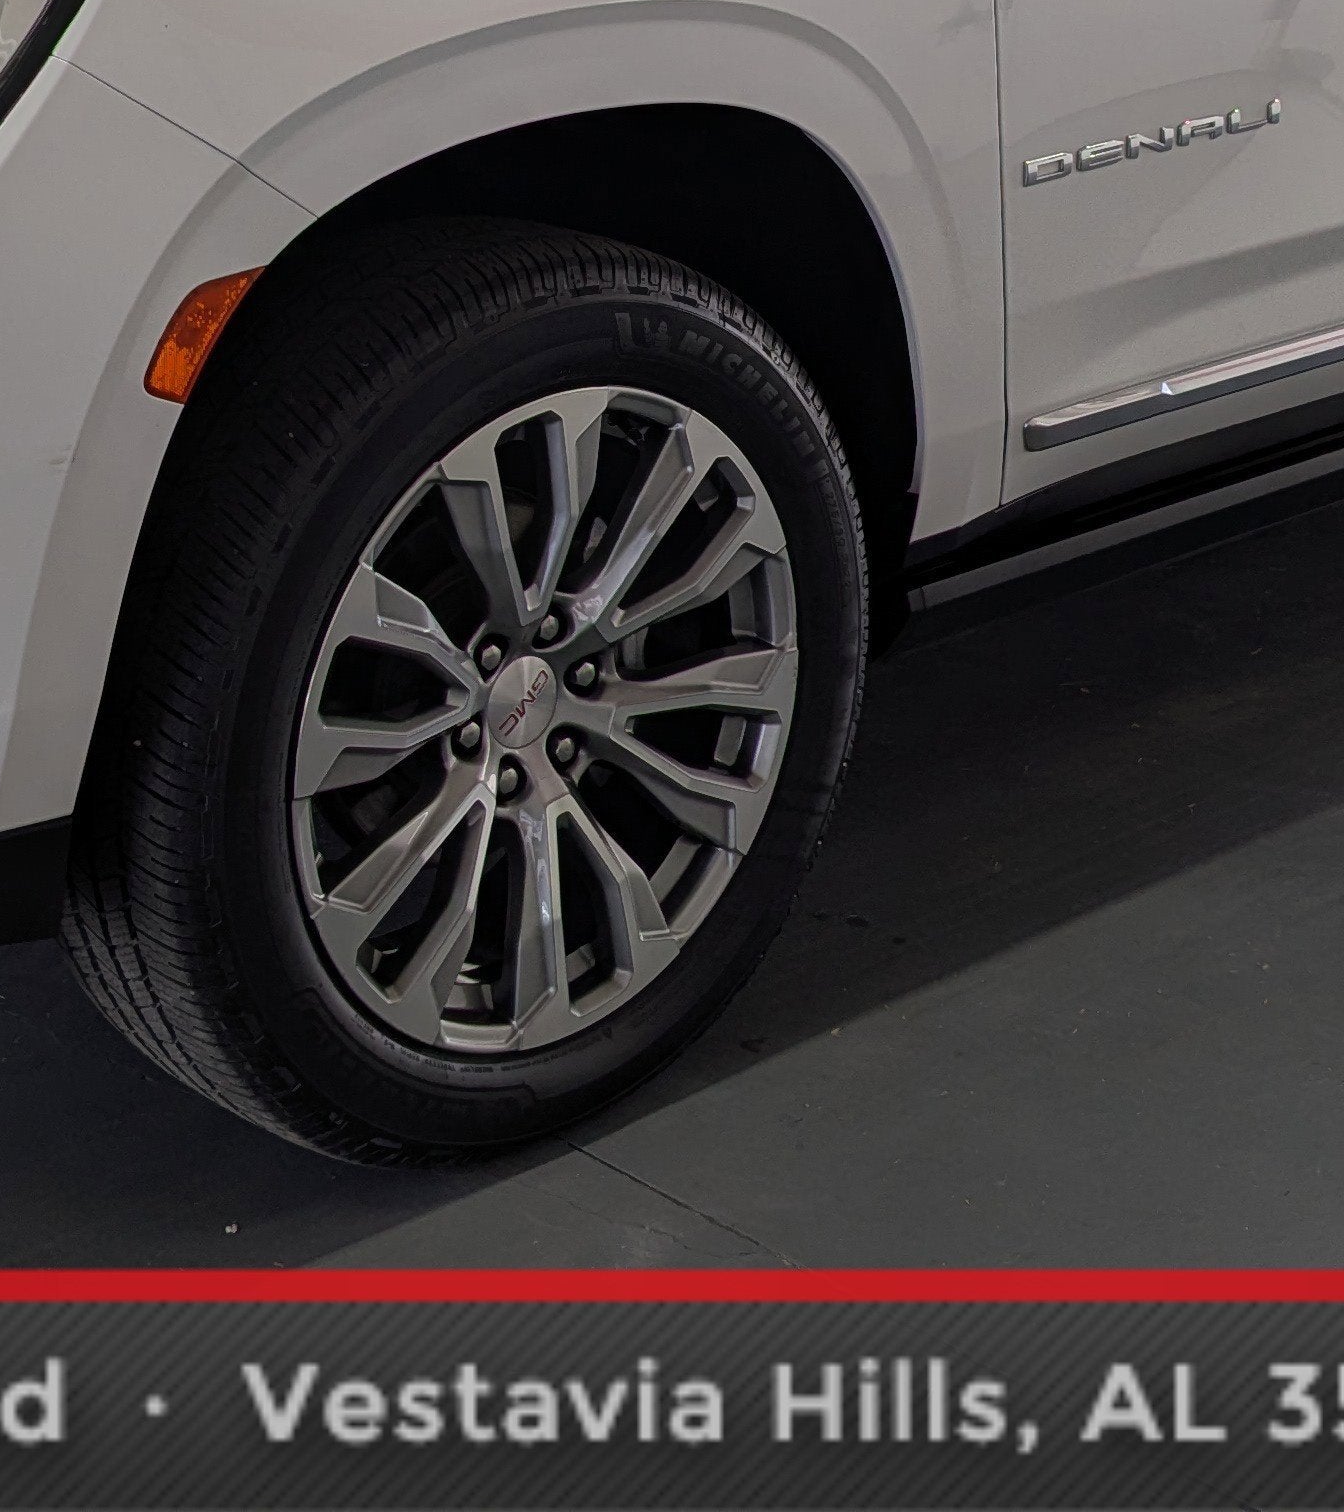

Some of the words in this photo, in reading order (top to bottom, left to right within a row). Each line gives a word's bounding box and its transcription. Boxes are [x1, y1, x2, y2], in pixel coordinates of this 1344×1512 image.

[1022, 97, 1282, 188] DENALI
[678, 328, 816, 457] MICHELIN
[497, 668, 549, 737] GMC
